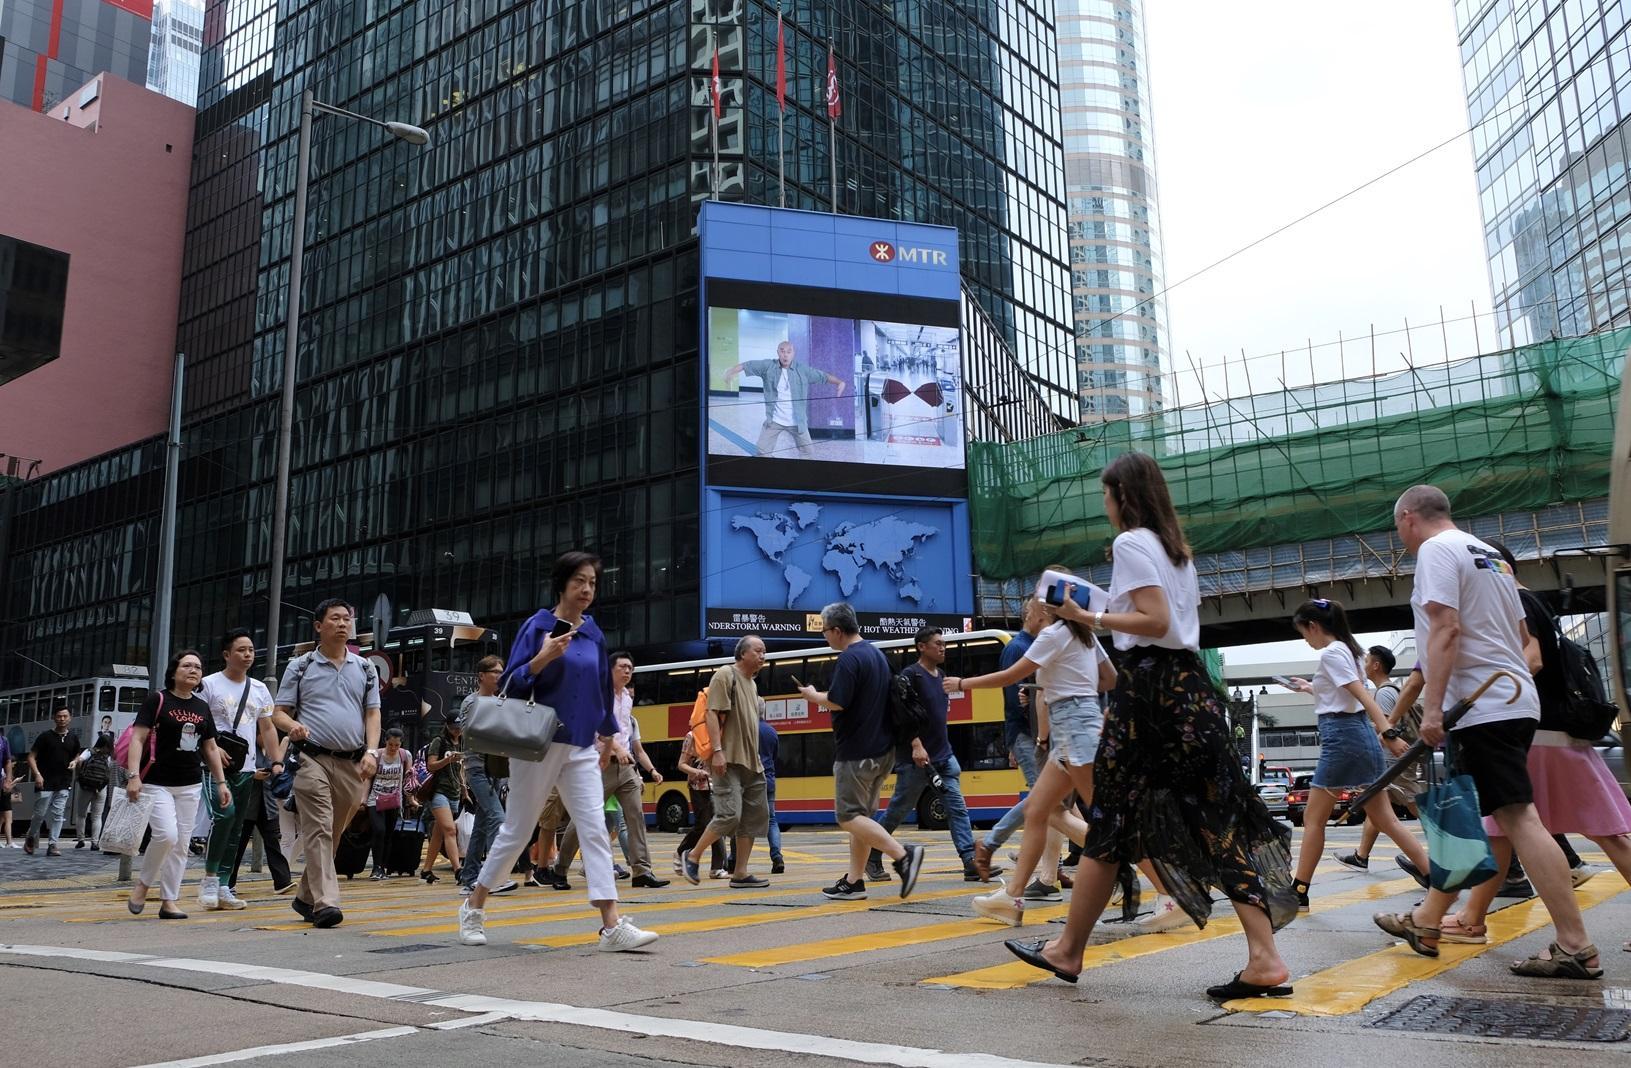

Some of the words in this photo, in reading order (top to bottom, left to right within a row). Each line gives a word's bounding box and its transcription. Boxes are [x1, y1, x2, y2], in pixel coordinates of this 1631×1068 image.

[899, 247, 947, 265] MTR
[708, 622, 760, 631] NDERSTORM
[761, 623, 801, 632] WARNING
[879, 617, 926, 627] 酷熱天氣警告
[434, 627, 443, 635] 39
[864, 625, 880, 634] HOT
[446, 675, 480, 686] CENTR
[168, 709, 204, 721] FEELING
[176, 715, 200, 724] GOOD
